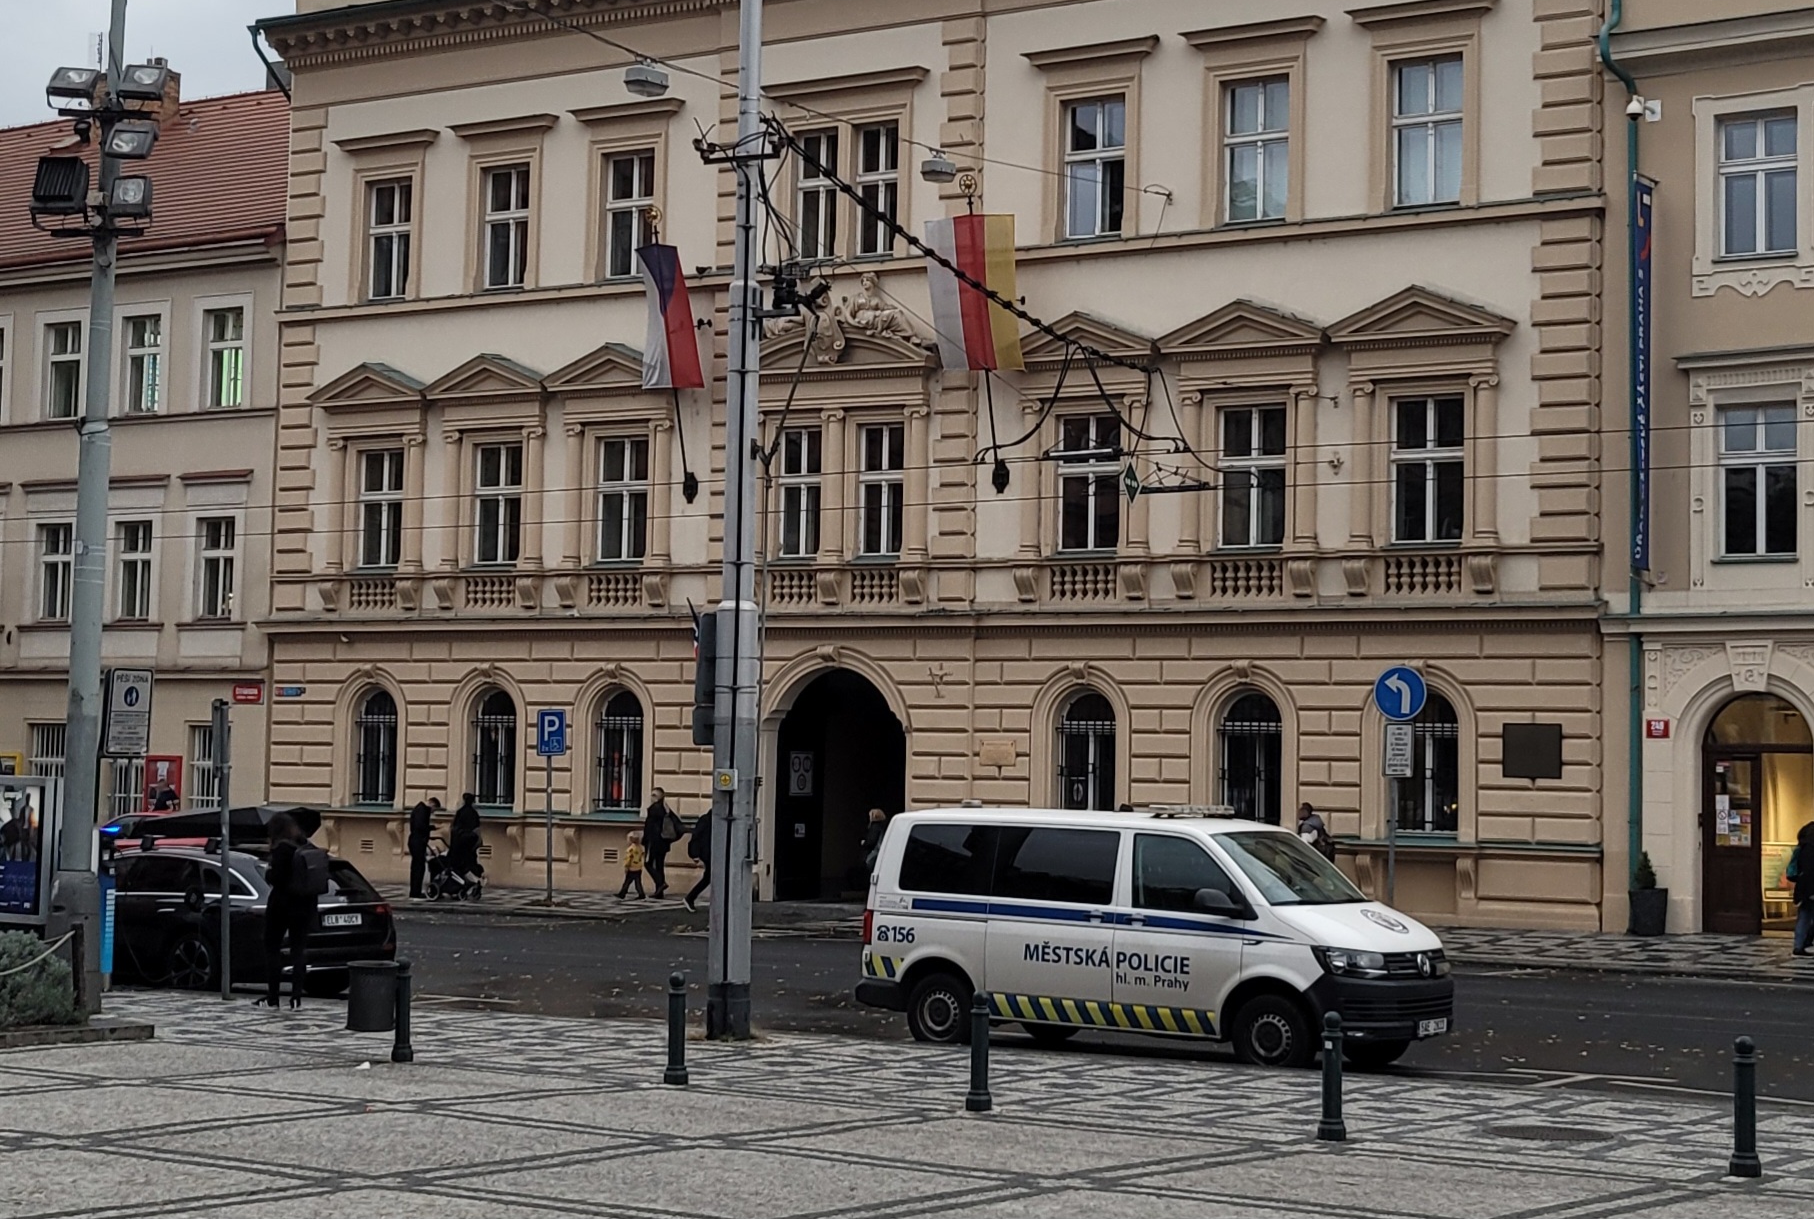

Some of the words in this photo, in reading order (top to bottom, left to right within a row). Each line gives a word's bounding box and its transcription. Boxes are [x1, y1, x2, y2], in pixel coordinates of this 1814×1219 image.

[544, 716, 559, 741] P
[891, 925, 915, 943] 156
[1023, 941, 1111, 968] MĚSTSKÁ
[1115, 951, 1190, 975] POLICIE
[1115, 972, 1131, 985] hl.
[1134, 975, 1150, 987] m.
[1153, 975, 1190, 992] Prahy
